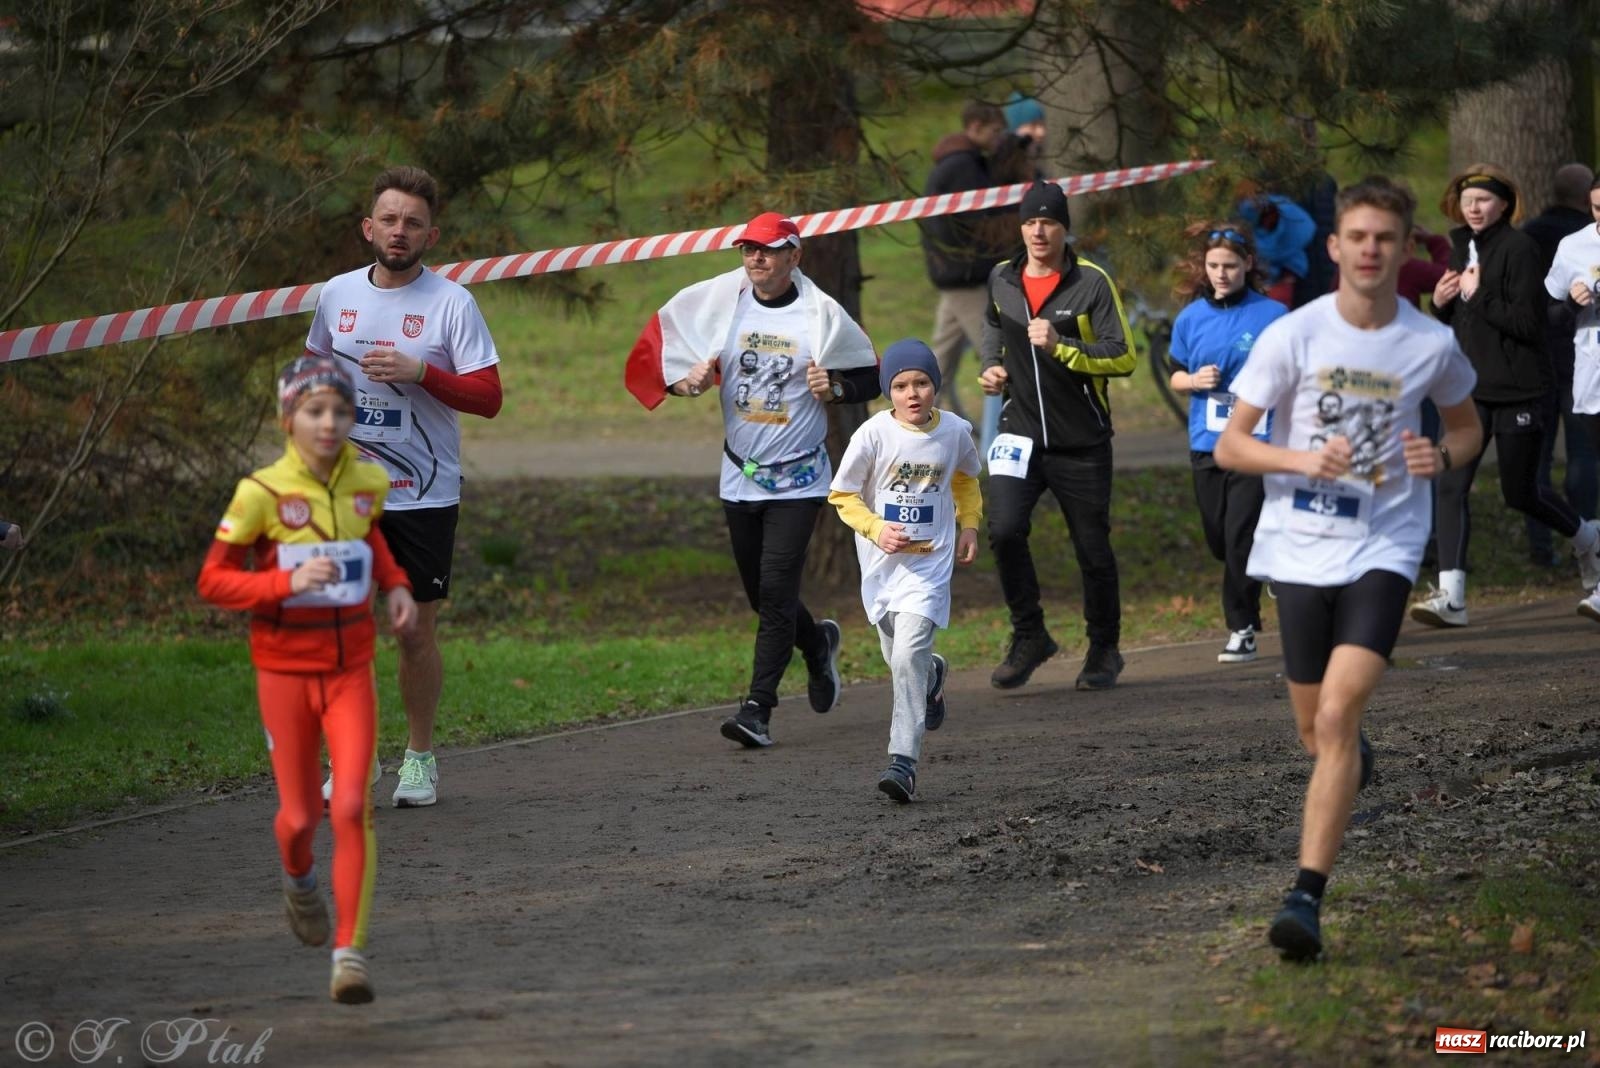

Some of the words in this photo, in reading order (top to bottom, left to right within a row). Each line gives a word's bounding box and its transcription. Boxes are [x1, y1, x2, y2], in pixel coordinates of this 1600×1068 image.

[363, 408, 385, 425] 79
[993, 446, 1014, 460] 142
[1308, 494, 1339, 516] 45
[898, 507, 921, 522] 80
